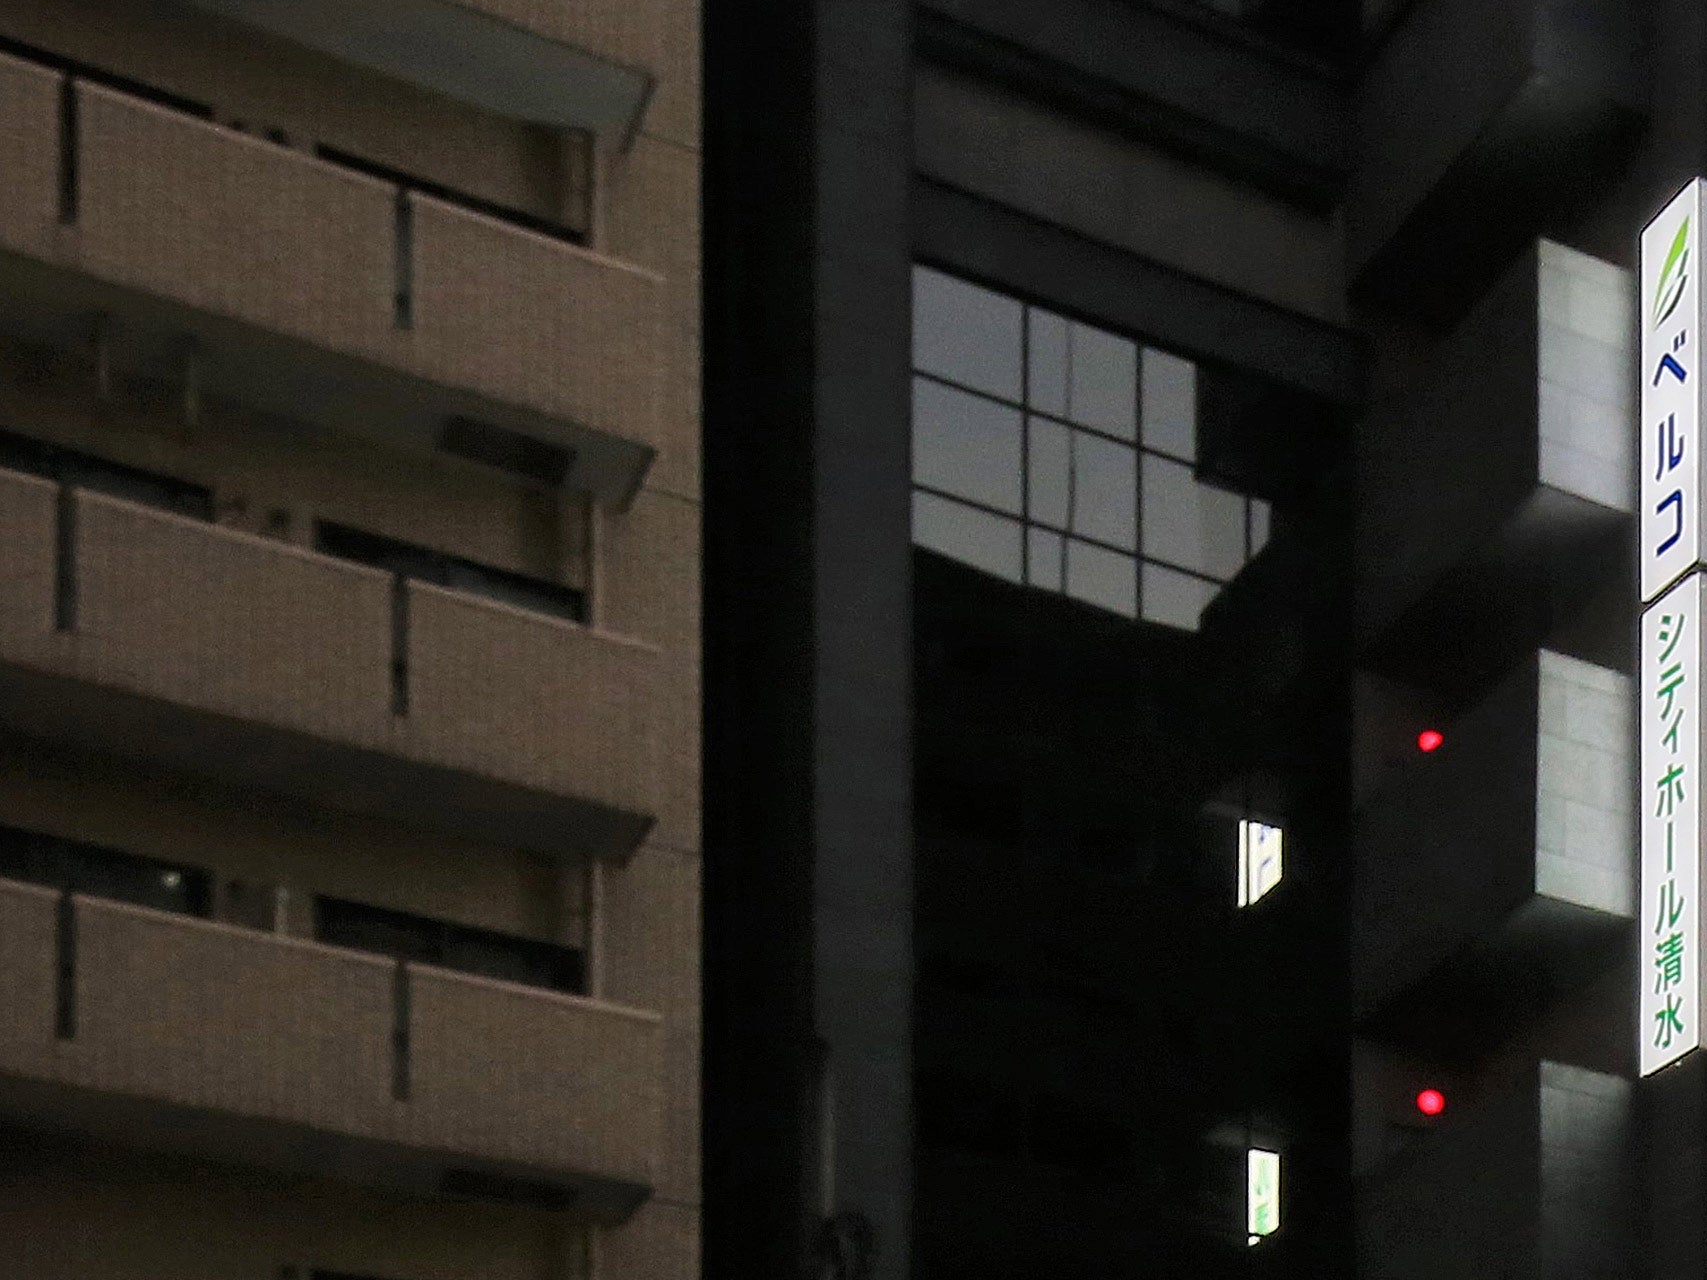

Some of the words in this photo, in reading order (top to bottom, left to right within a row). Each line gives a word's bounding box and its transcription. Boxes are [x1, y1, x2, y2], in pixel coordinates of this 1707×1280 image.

[1651, 332, 1689, 556] ベルコ
[1652, 612, 1686, 1050] シティホール清水
